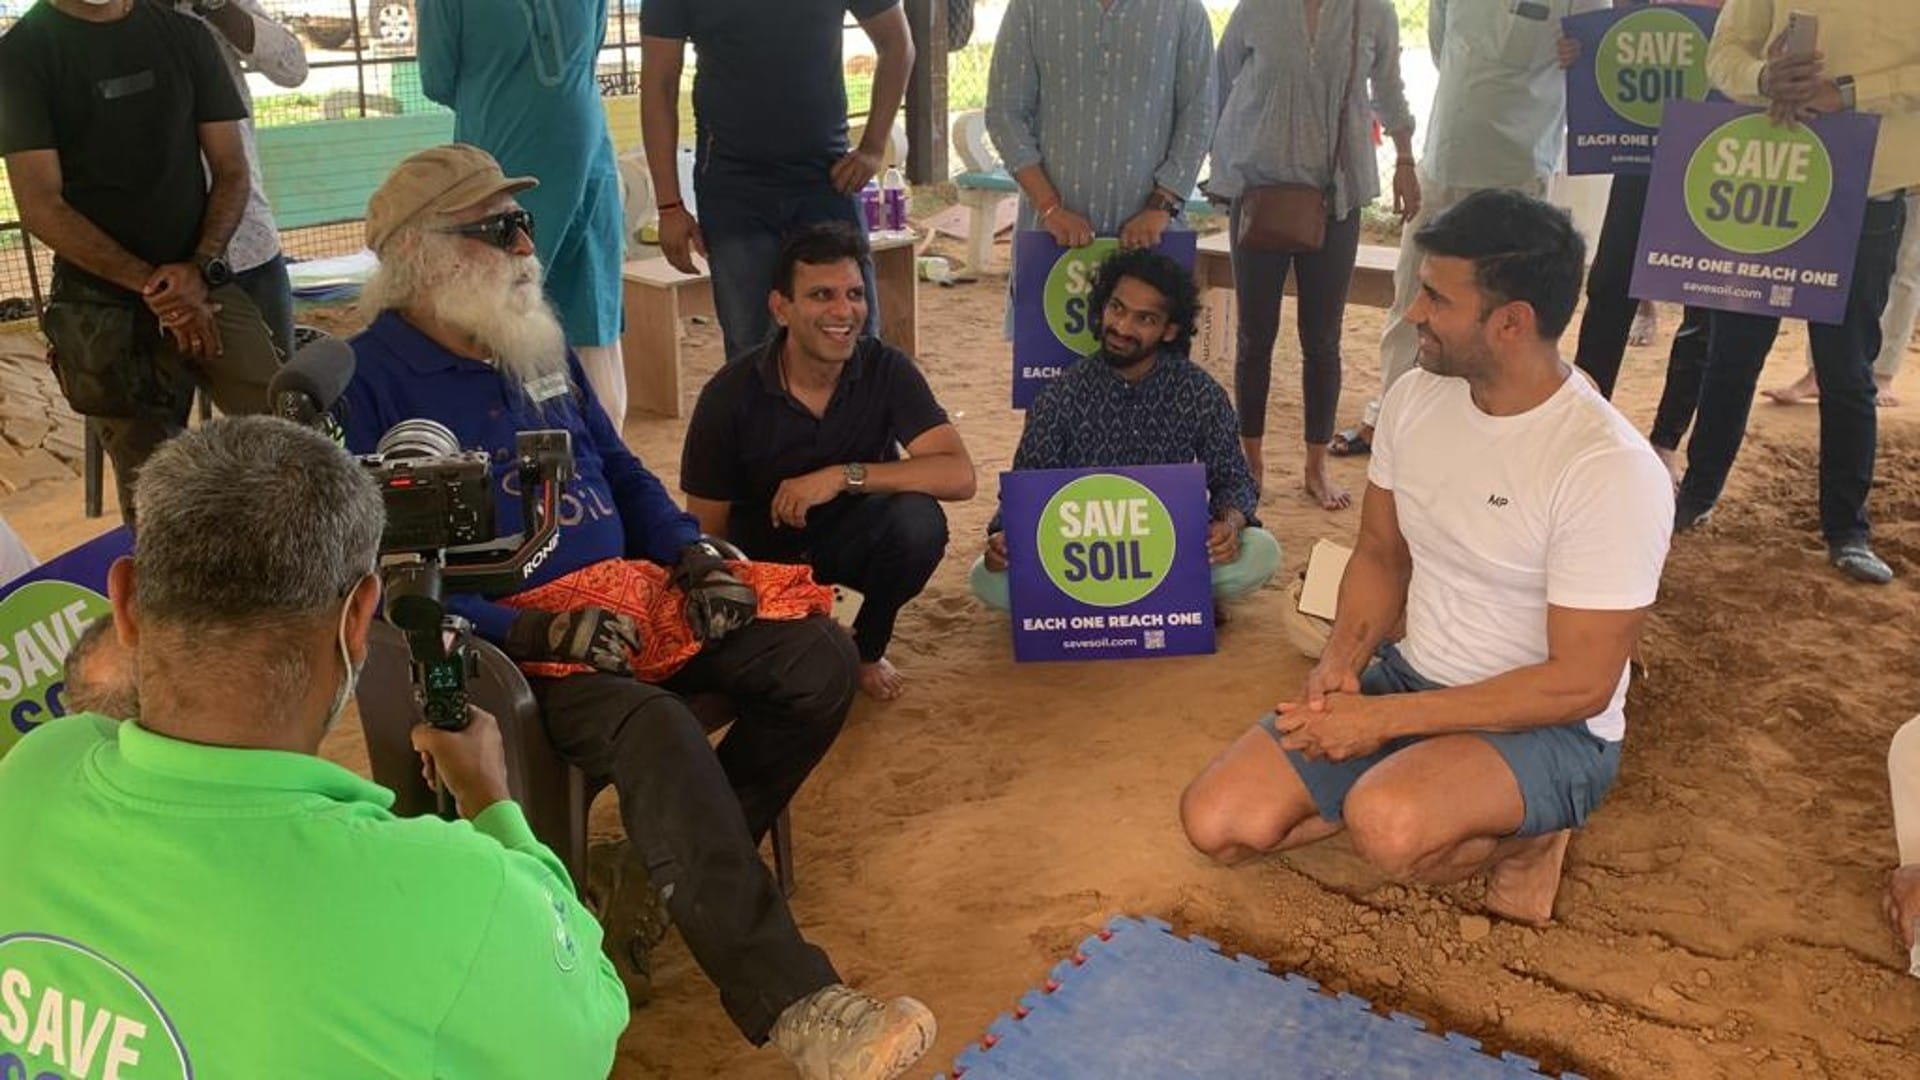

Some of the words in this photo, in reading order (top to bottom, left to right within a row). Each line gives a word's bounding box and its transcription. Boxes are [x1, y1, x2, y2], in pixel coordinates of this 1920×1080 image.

[1616, 31, 1694, 66] SAVE
[1577, 134, 1617, 146] EACH
[1619, 134, 1649, 146] ONE
[1712, 138, 1812, 182] SAVE
[1705, 179, 1798, 229] SOIL
[1647, 252, 1696, 270] EACH
[1697, 258, 1733, 274] ONE
[1737, 263, 1797, 282] REACH
[1800, 269, 1839, 286] ONE
[1683, 280, 1762, 299] savesoil.com
[1022, 366, 1062, 378] EACH
[1058, 498, 1150, 539] SAVE
[1063, 540, 1153, 582] SOIL
[1023, 617, 1067, 631] EACH
[1070, 616, 1105, 629] ONE
[1109, 614, 1164, 628] REACH
[1167, 612, 1202, 625] ONE
[1063, 637, 1137, 649] savesoil.com
[0, 967, 147, 1080] SAVE
